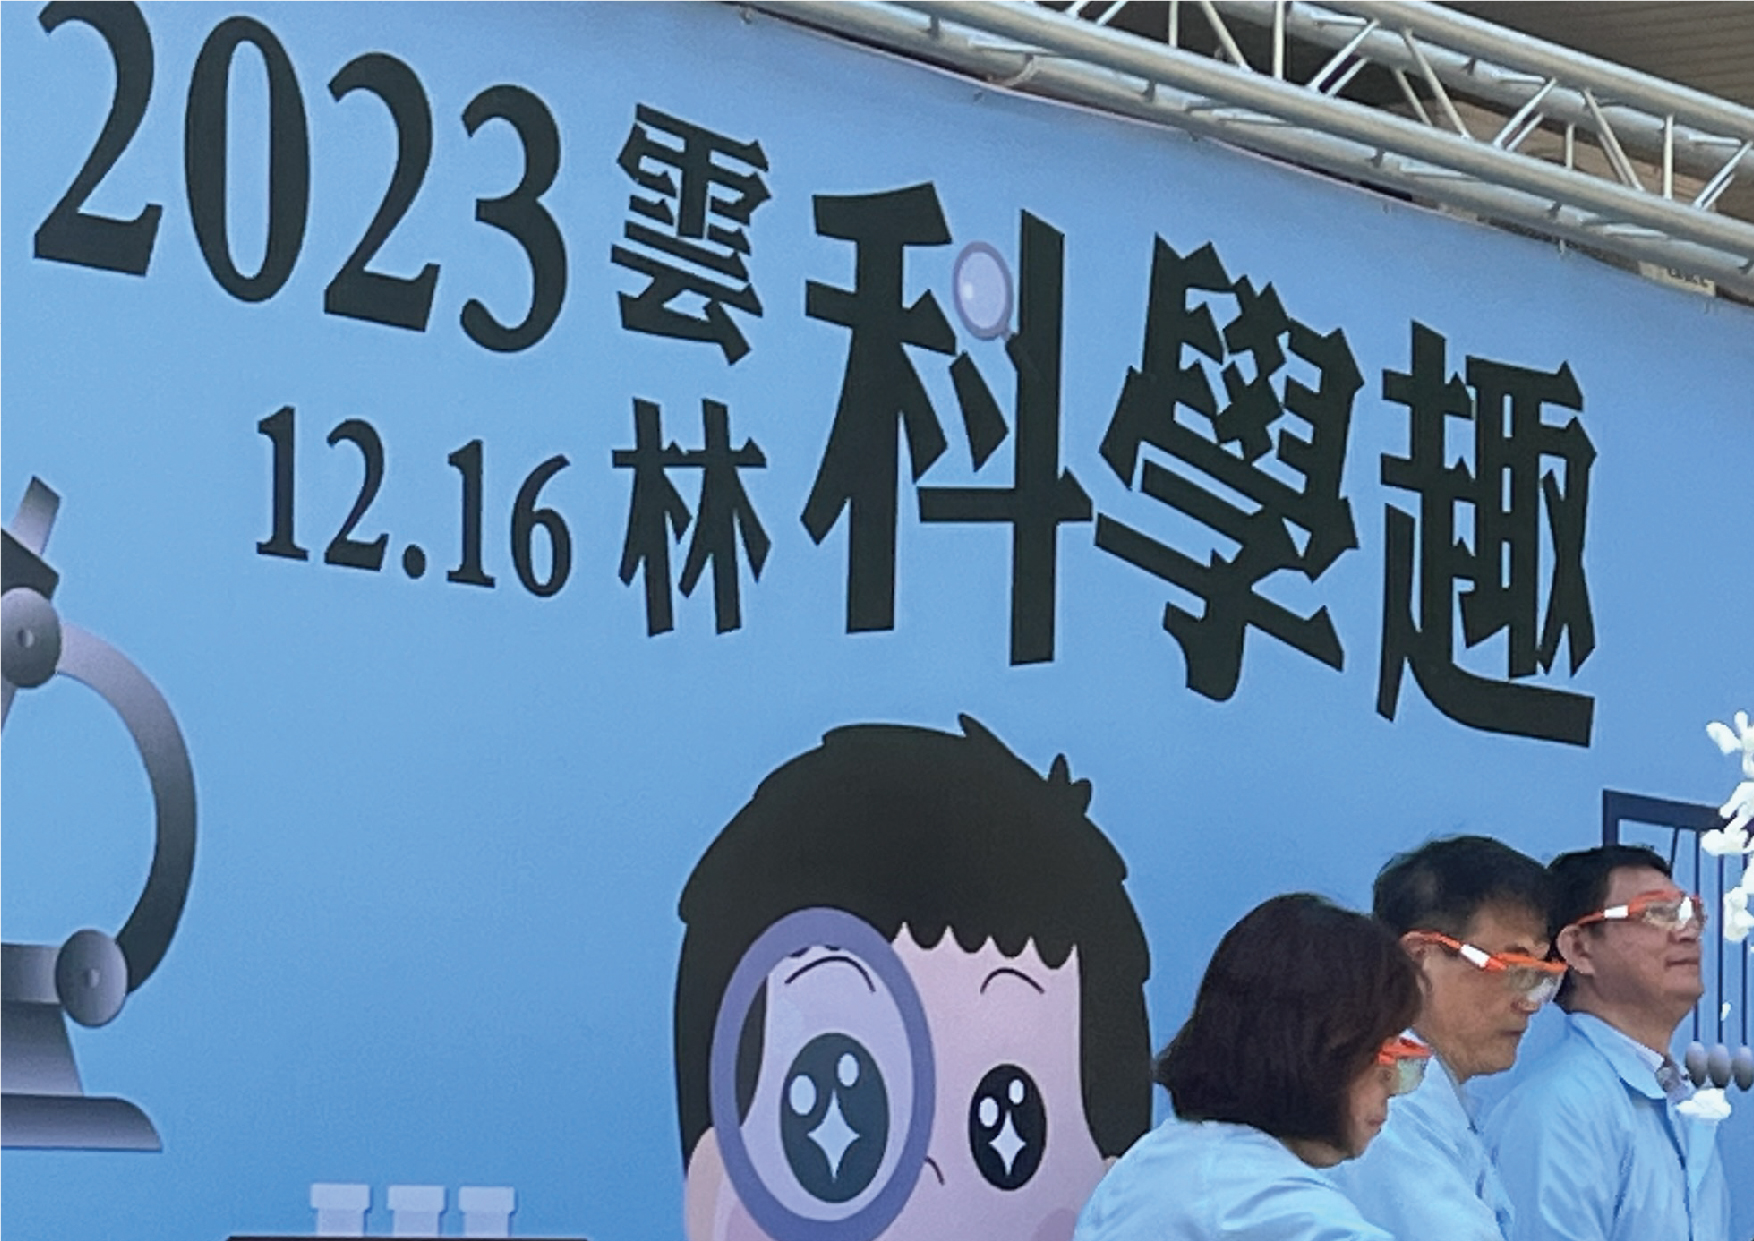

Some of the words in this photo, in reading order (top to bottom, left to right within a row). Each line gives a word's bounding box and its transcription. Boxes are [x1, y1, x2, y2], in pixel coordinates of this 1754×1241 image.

[33, 1, 568, 354] 2023
[256, 405, 572, 599] 12.16
[610, 102, 773, 638] 雲林
[800, 181, 1598, 749] 科學趣
